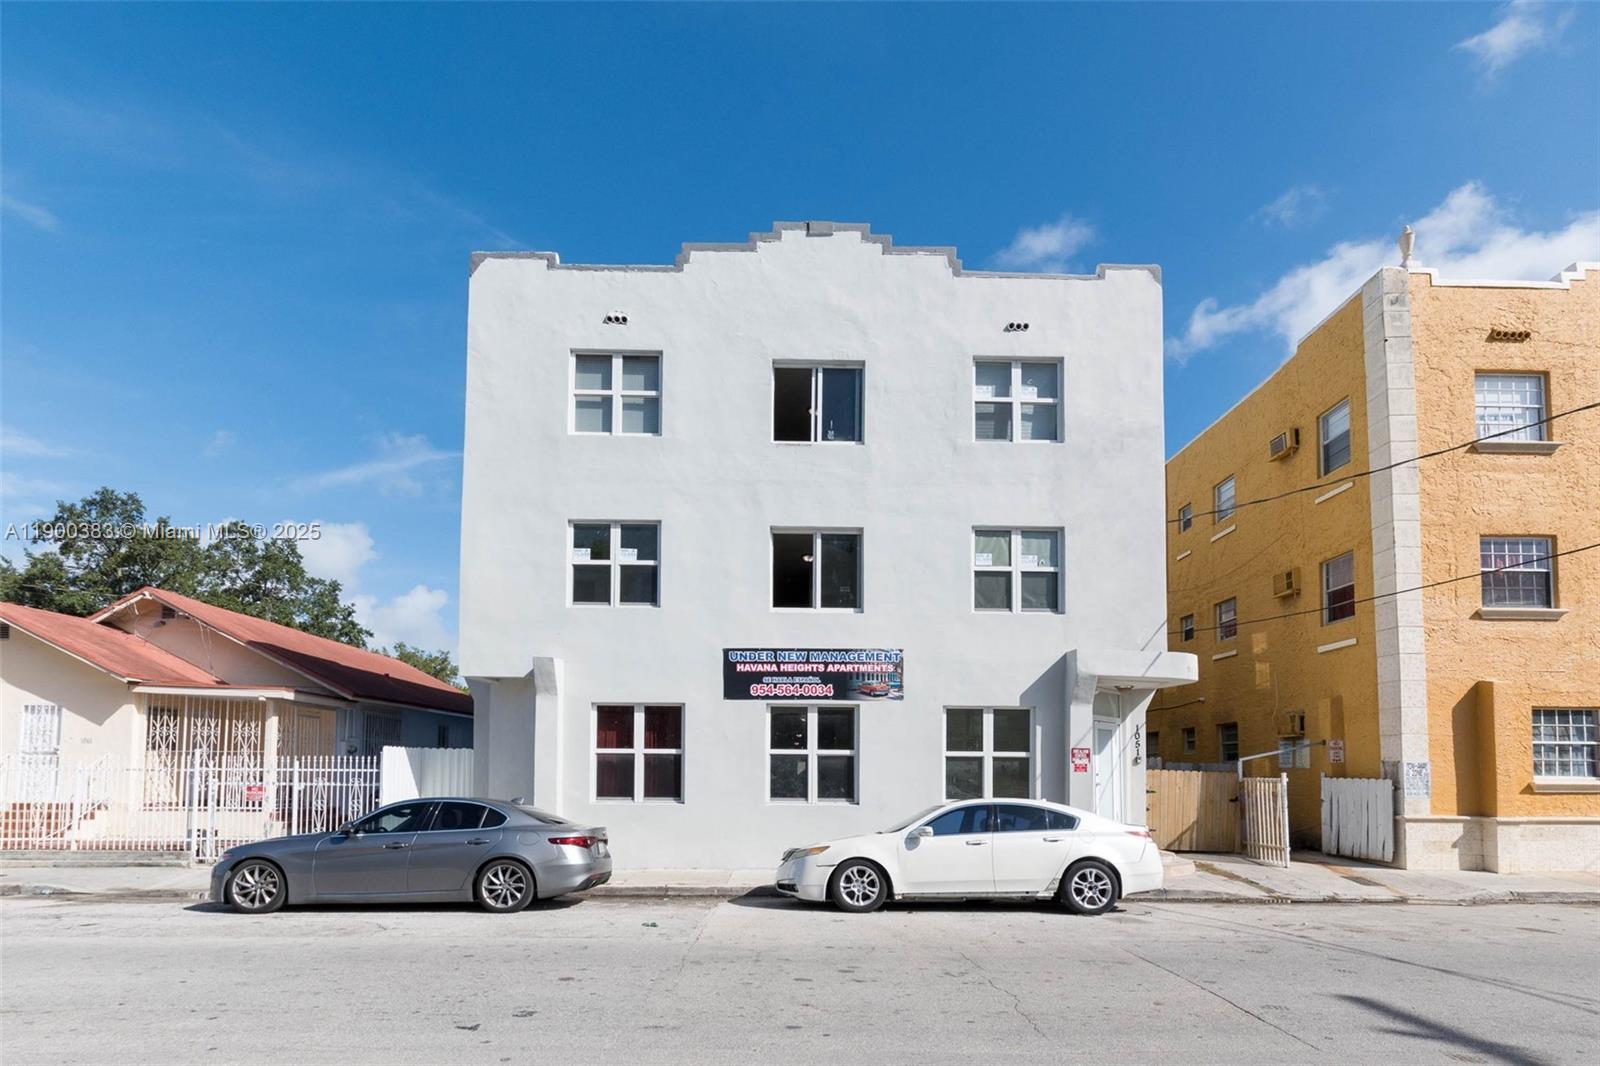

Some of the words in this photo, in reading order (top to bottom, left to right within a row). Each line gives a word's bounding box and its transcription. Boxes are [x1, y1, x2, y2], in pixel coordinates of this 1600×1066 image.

[729, 651, 775, 662] UNDER
[777, 651, 807, 662] NEW
[809, 651, 902, 662] MANAGEMENT
[736, 664, 778, 672] HAVANA
[780, 663, 825, 672] HEIGHTS
[827, 663, 894, 672] APARTMENTS
[750, 684, 833, 696] 954-564-0034
